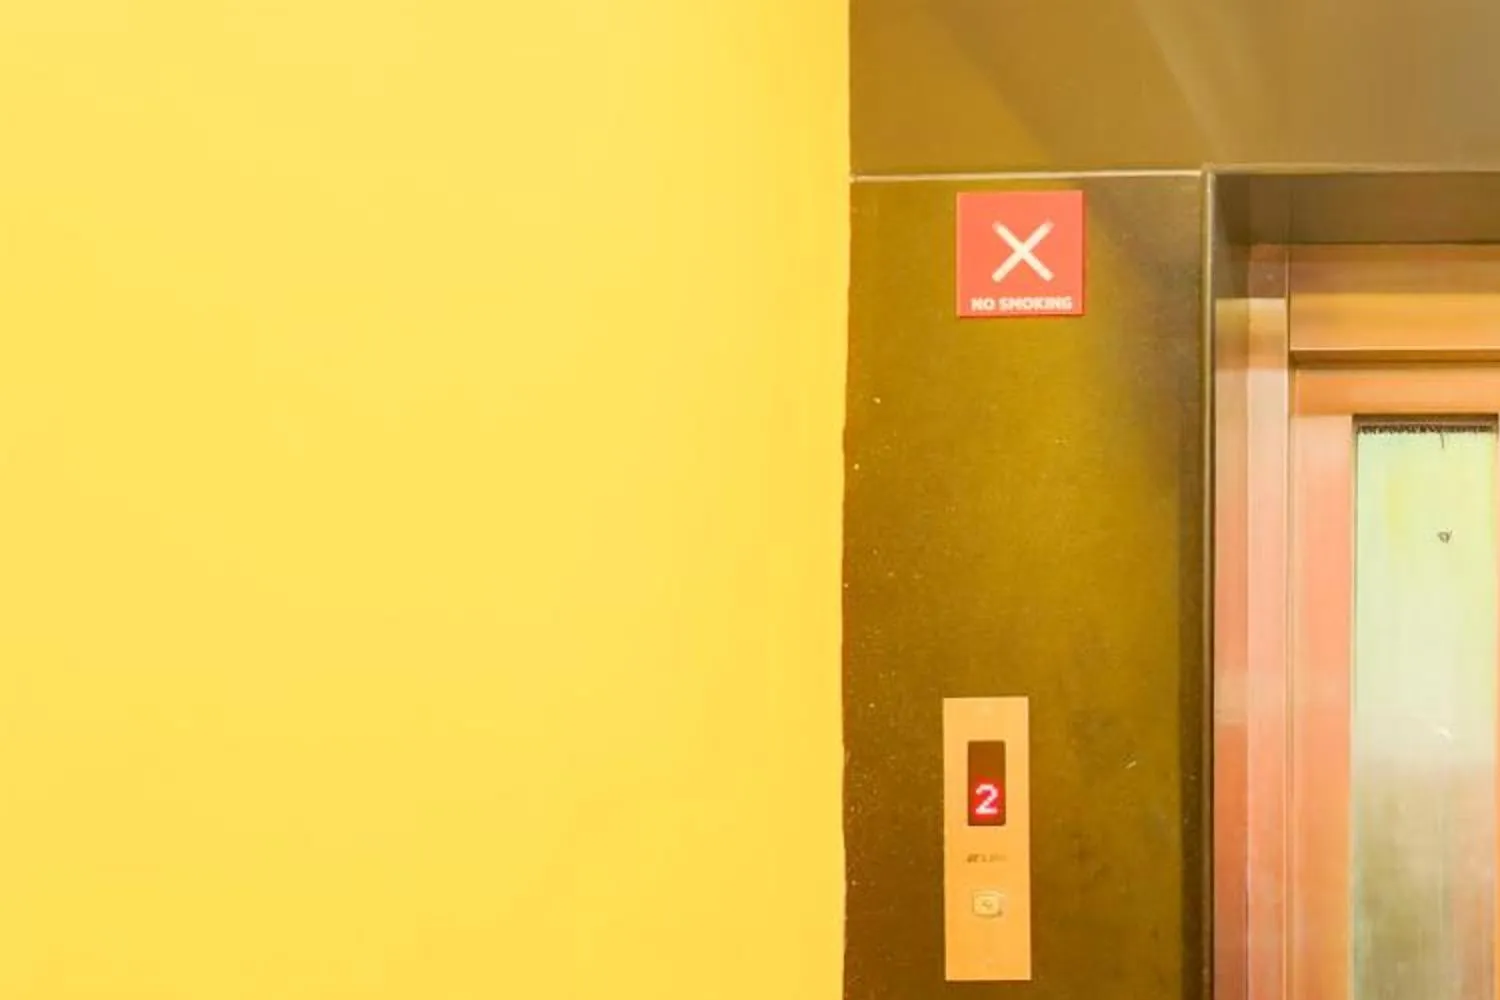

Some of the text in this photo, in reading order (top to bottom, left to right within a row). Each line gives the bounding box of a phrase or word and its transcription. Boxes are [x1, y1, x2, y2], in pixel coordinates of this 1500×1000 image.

[971, 296, 1073, 311] NO SMOKING
[974, 783, 999, 815] 2
